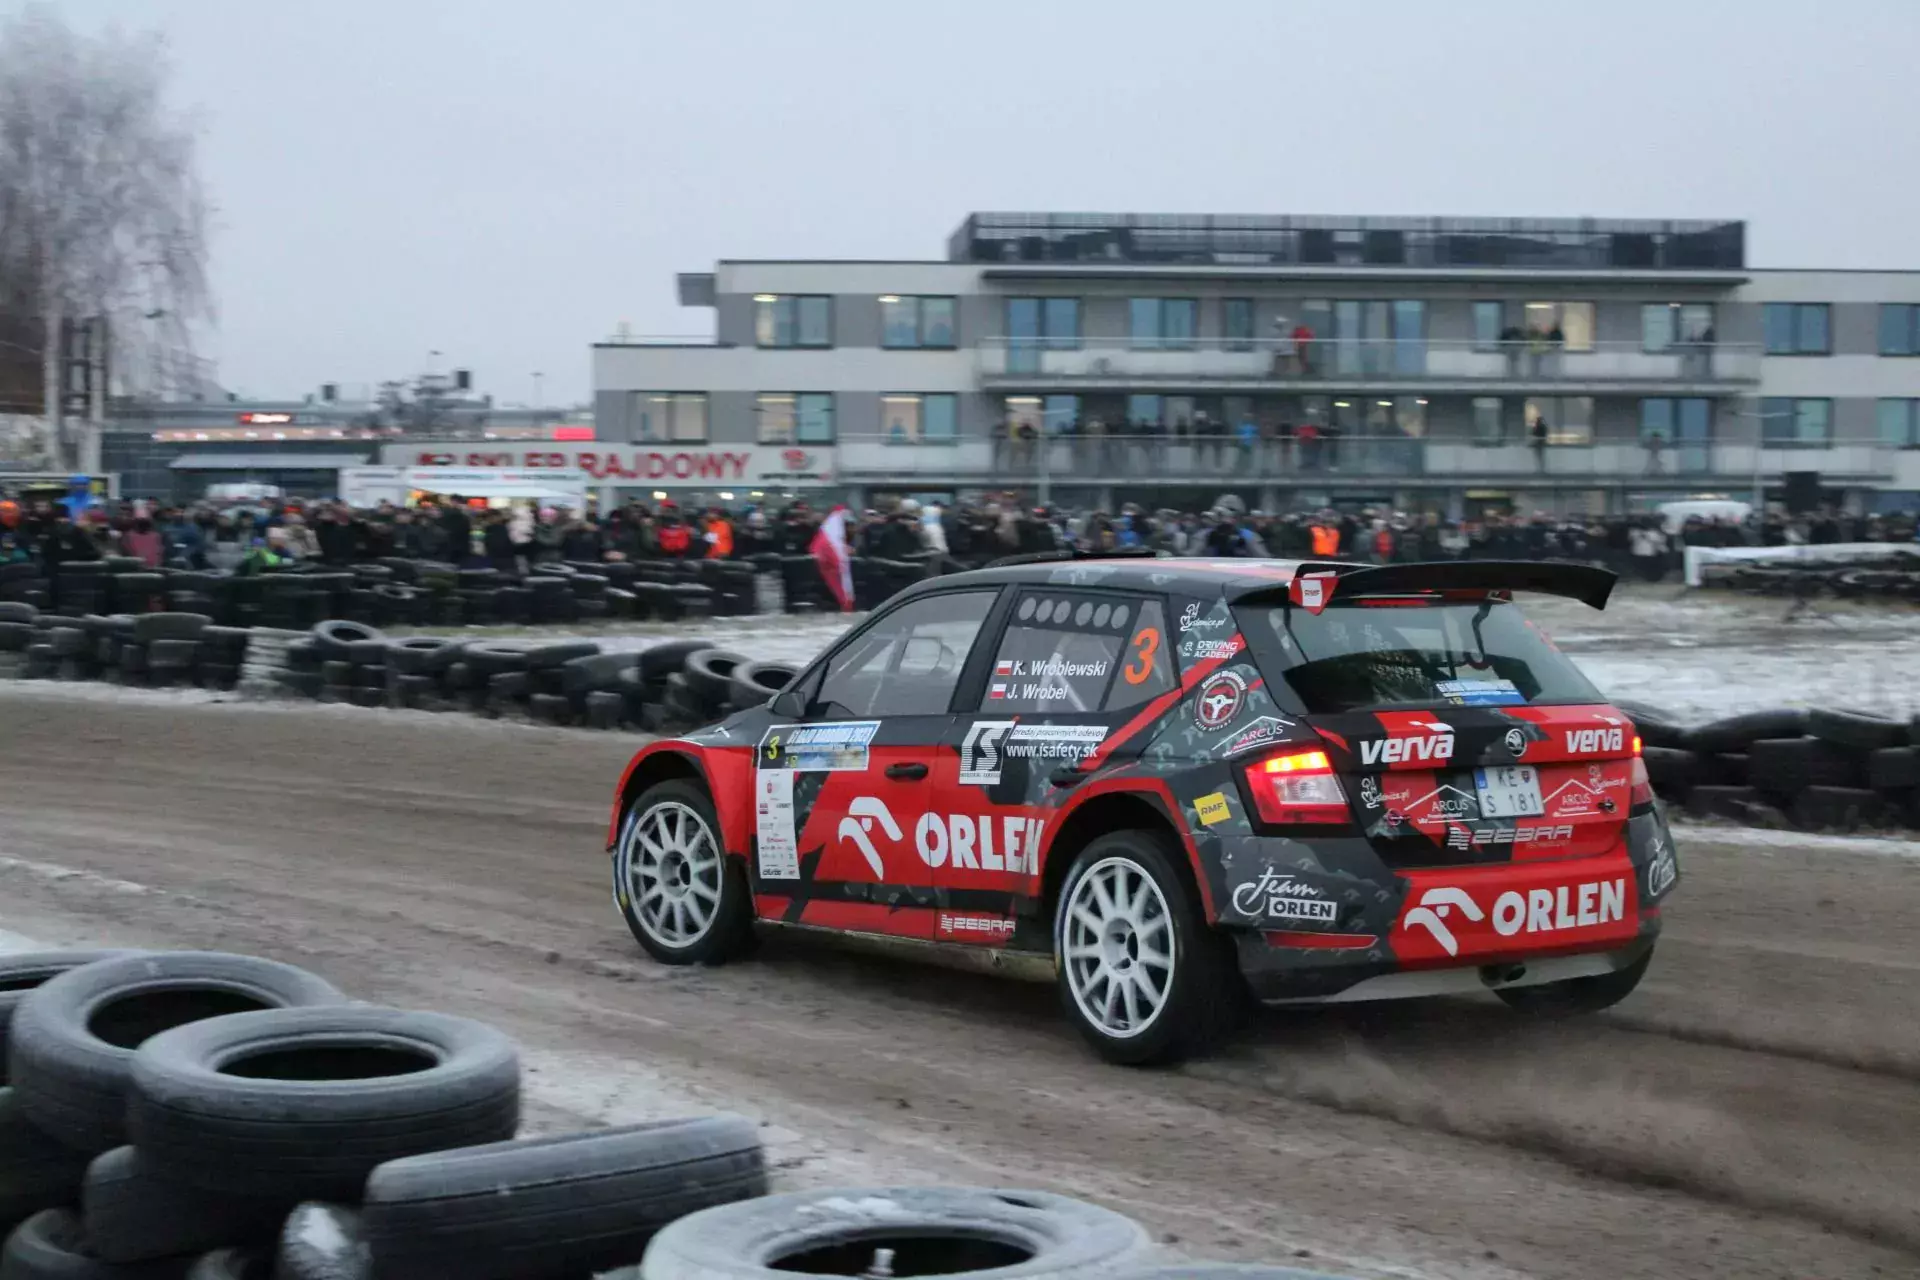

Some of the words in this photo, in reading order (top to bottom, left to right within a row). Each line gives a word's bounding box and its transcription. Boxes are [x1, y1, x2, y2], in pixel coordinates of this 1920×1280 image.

[576, 452, 751, 480] RAJDOWY
[1193, 650, 1236, 659] ACADEMY
[1196, 640, 1239, 650] DRIVING
[1124, 627, 1159, 684] 3
[1012, 661, 1027, 676] K.
[1030, 660, 1107, 677] Wroblewski
[1007, 684, 1018, 700] J.
[1021, 683, 1069, 700] Wrobel
[1241, 725, 1284, 742] ARCUS
[1565, 728, 1623, 754] verva
[767, 735, 780, 760] 3
[1006, 742, 1099, 762] www.isafety.sk
[1360, 733, 1455, 765] verva
[1497, 766, 1518, 787] KE
[1201, 802, 1224, 816] RMF
[1431, 799, 1469, 813] ARCUS
[1508, 793, 1538, 812] 181
[1561, 793, 1592, 806] ARCUS
[915, 811, 1045, 876] ORLEN
[1471, 824, 1574, 845] ZEBRA
[1273, 900, 1333, 918] ORLEN
[1491, 878, 1626, 937] ORLEN
[953, 917, 1017, 933] ZEBRA
